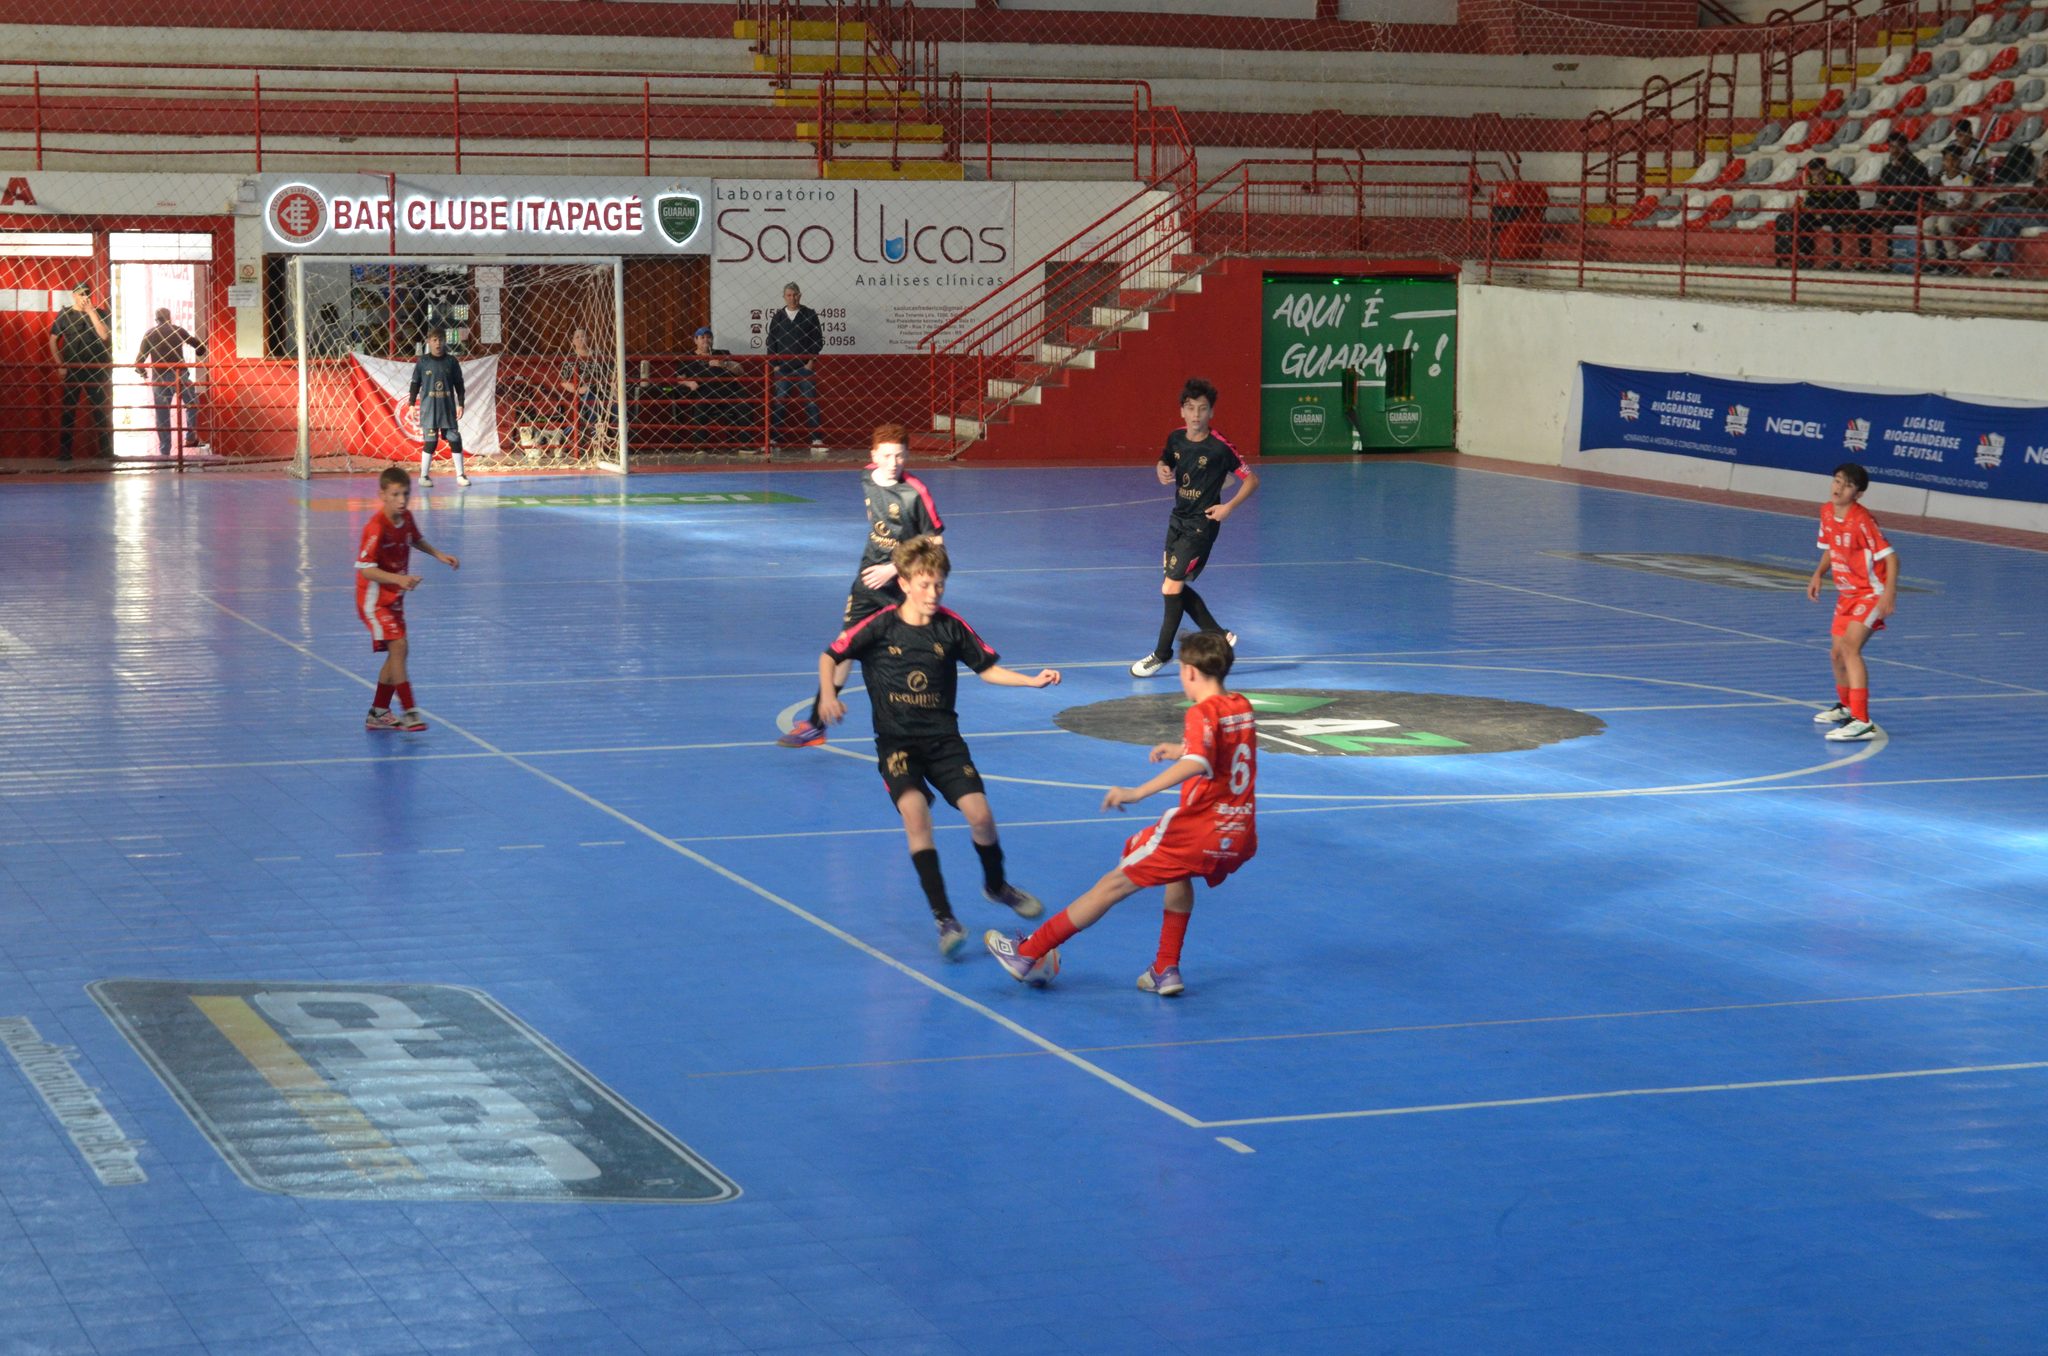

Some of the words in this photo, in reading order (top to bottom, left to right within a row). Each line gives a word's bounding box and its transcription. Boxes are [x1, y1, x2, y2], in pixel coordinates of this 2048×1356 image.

[716, 187, 836, 202] Laboratório
[334, 200, 395, 230] BAR
[408, 200, 508, 230] CLUBE
[516, 194, 643, 231] ITAPAGÉ
[662, 206, 695, 217] GUARANI
[716, 208, 835, 264] São
[853, 188, 1007, 264] Lucas
[855, 273, 930, 287] Análises
[936, 273, 1005, 287] clínicas
[1273, 293, 1351, 336] AQUI
[1361, 289, 1384, 328] É
[821, 322, 847, 332] 1343
[1666, 390, 1686, 401] LIGA
[1687, 392, 1701, 404] SUL
[1293, 413, 1322, 424] GUARANI
[1389, 411, 1418, 422] GUARANI
[1651, 401, 1715, 419] RIOGRANDENSE
[1660, 414, 1671, 426] DE
[1672, 416, 1701, 430] FUTSAL
[1765, 416, 1824, 440] NEDEL
[1903, 416, 1926, 430] LIGA
[1927, 418, 1945, 433] SUL
[1883, 429, 1962, 449] RIOGRANDENSE
[1893, 444, 1908, 457] DE
[1908, 446, 1943, 462] FUTSAL
[1229, 743, 1251, 795] 6
